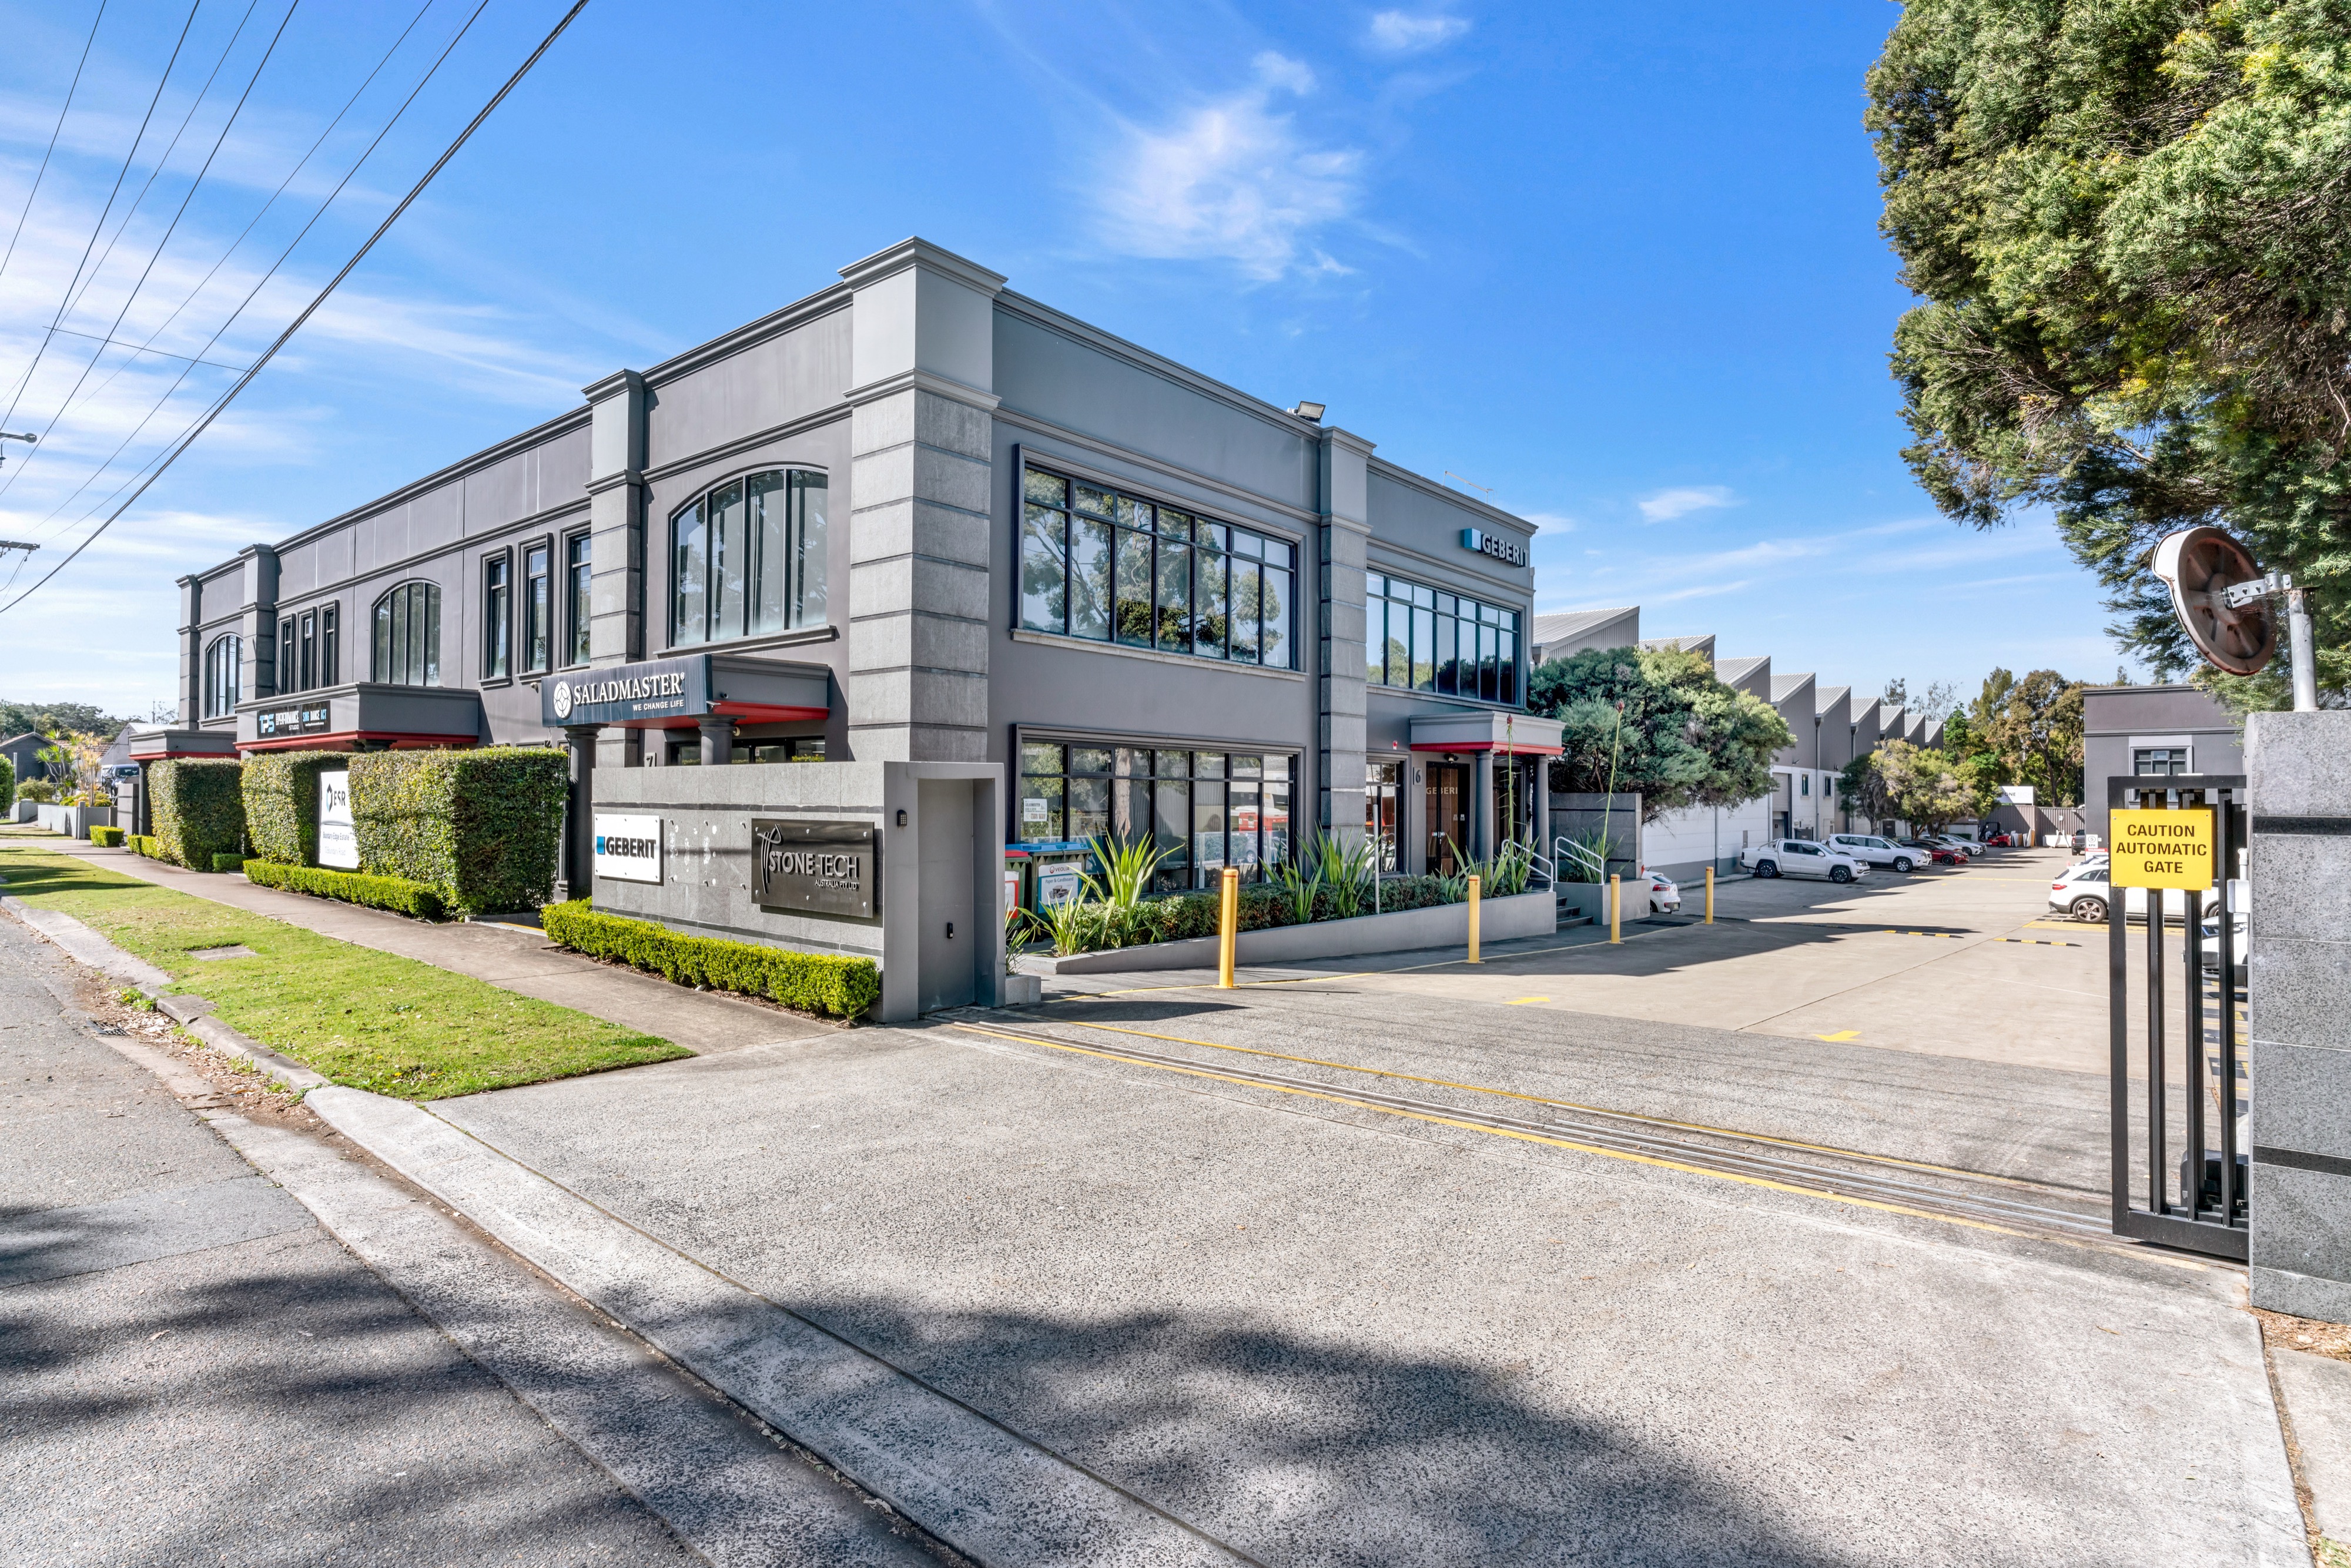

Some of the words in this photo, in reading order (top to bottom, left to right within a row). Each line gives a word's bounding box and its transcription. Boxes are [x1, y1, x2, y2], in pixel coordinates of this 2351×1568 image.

[1482, 533, 1529, 567] GEBERIT
[644, 701, 668, 711] CHANGE
[671, 699, 684, 708] LIFE
[310, 709, 320, 721] DANCE
[259, 713, 274, 733] TPS
[1416, 769, 1421, 783] 6
[334, 790, 346, 806] ESR
[2127, 824, 2195, 837] CAUTION
[606, 836, 657, 858] GEBERIT
[2116, 842, 2207, 856] AUTOMATIC
[2144, 861, 2183, 873] GATE
[815, 879, 839, 888] AUSTRALIA
